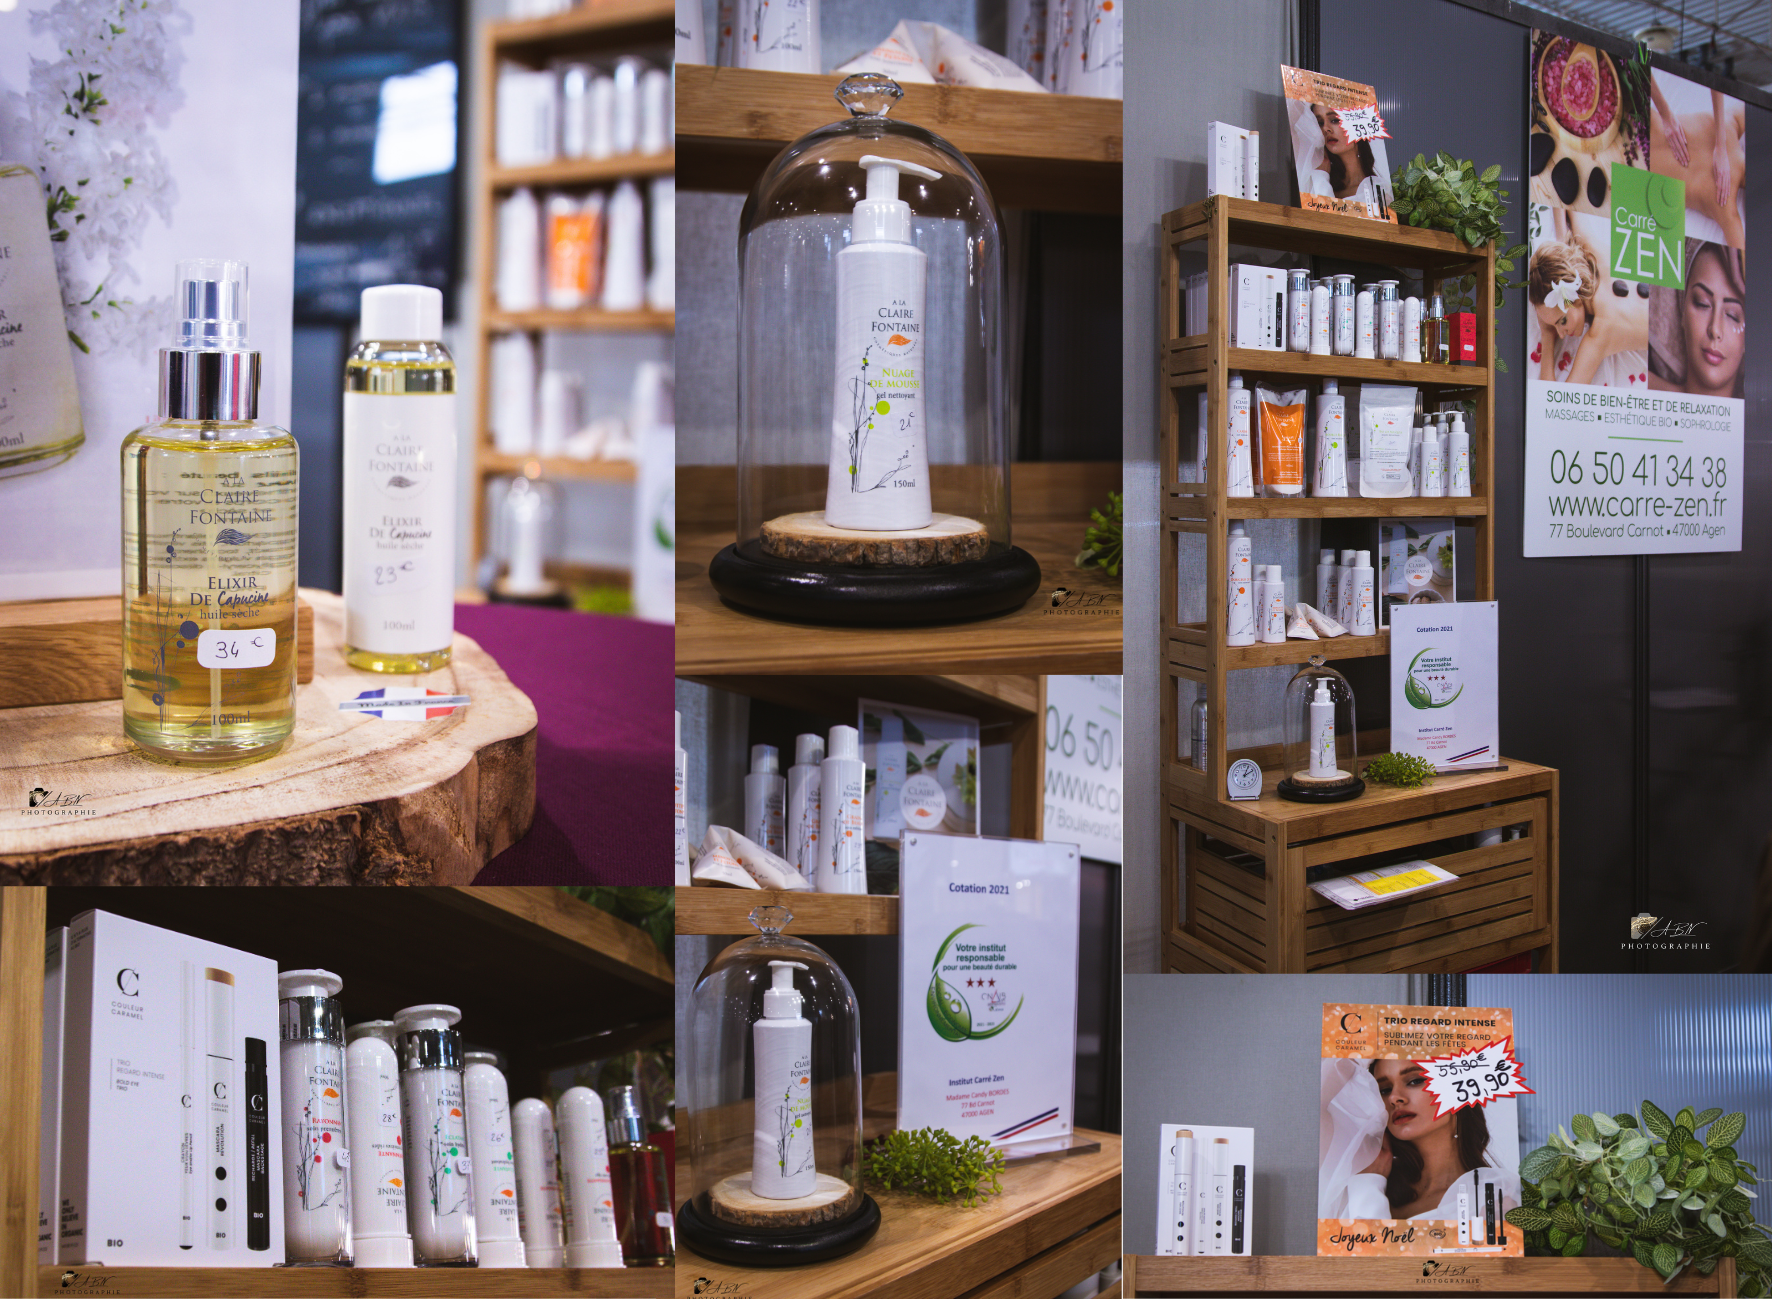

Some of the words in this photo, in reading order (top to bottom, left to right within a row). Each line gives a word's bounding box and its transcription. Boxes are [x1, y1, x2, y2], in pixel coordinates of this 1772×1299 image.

[1616, 206, 1656, 232] Carré
[1614, 227, 1682, 283] ZEN
[878, 308, 914, 318] CLAIRE
[872, 322, 920, 333] FONTAINE
[882, 368, 915, 378] NUAGE
[870, 380, 883, 388] DE
[886, 380, 920, 389] MOUSSE
[877, 392, 887, 400] gel
[1546, 390, 1580, 404] SOINS
[1584, 393, 1597, 406] DE
[1600, 394, 1650, 410] BIEN-ÊTRE
[1652, 400, 1664, 411] ET
[1666, 401, 1678, 412] DE
[1680, 403, 1731, 416] RELAXATION
[1545, 408, 1595, 422] MASSAGES
[1604, 412, 1656, 426] ESTHÉTIQUE
[1658, 416, 1672, 427] BIO
[1680, 418, 1731, 432] SOPHROLOGIE
[376, 444, 423, 456] CLAIRE
[369, 460, 433, 472] FONTAINE
[1550, 450, 1583, 484] 06
[1593, 451, 1624, 485] 50
[1632, 454, 1657, 486] 41
[1666, 455, 1694, 487] 34
[1702, 457, 1727, 488] 38
[894, 480, 916, 488] 150ml
[200, 489, 259, 504] CLAIRE
[1549, 491, 1727, 517] www.carre-zen.fr
[190, 510, 272, 525] FONTAINE
[382, 516, 422, 526] ELIXIR
[370, 528, 387, 538] DE
[390, 527, 432, 540] Capucine
[1550, 524, 1563, 538] 77
[1567, 524, 1624, 538] Boulevard
[1627, 523, 1664, 538] Carnot
[1672, 523, 1700, 536] 47000
[1702, 525, 1725, 539] Agen
[208, 577, 257, 590] ELIXIR
[190, 593, 212, 606] DE
[218, 590, 269, 607] Capucine
[200, 608, 229, 620] huile
[231, 607, 260, 618] sèche
[383, 620, 415, 631] 100ml
[215, 641, 239, 659] 34
[211, 711, 251, 726] 100ml
[1046, 705, 1076, 757] 06
[1084, 720, 1113, 771] 50
[907, 786, 936, 797] CLAIRE
[904, 798, 942, 808] FONTAINE
[1058, 808, 1110, 840] Boulevard
[949, 882, 987, 893] Cotation
[989, 885, 1010, 895] 2021
[955, 943, 977, 952] Votre
[979, 943, 1006, 952] institut
[956, 954, 1005, 963] responsable
[116, 968, 139, 997] C
[112, 1001, 144, 1012] COULEUR
[111, 1009, 143, 1020] CARAMEL
[1340, 1012, 1362, 1034] C
[1384, 1017, 1408, 1025] TRIO
[1410, 1018, 1452, 1026] REGARD
[1454, 1019, 1496, 1027] INTENSE
[1384, 1032, 1424, 1040] SUBLIMEZ
[1442, 1039, 1466, 1047] FÊTES
[117, 1067, 140, 1076] REGARD
[142, 1071, 165, 1080] INTENSE
[949, 1078, 972, 1086] Institut
[974, 1076, 992, 1084] Carré
[214, 1082, 226, 1099] C
[181, 1095, 191, 1108] C
[251, 1094, 263, 1111] C
[107, 1239, 123, 1247] BIO
[1330, 1227, 1377, 1251] Joyeux
[1382, 1227, 1415, 1244] Noël
